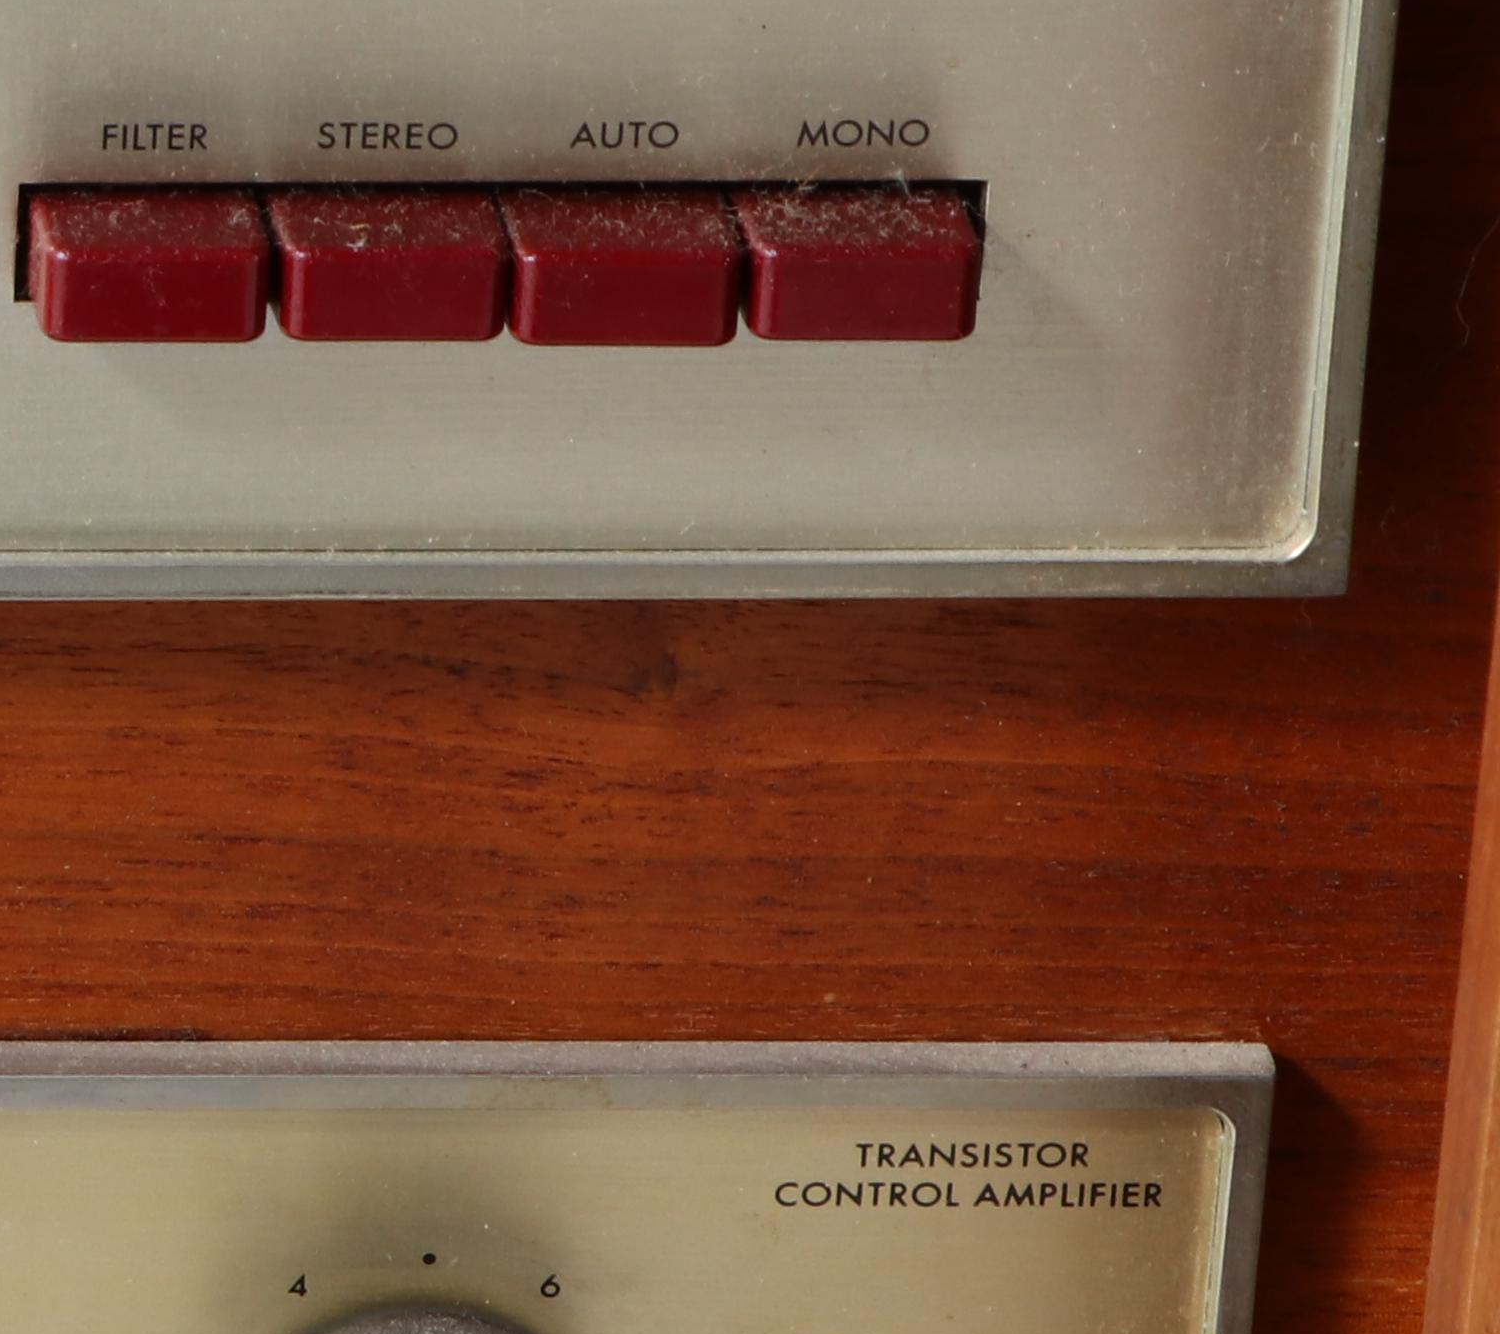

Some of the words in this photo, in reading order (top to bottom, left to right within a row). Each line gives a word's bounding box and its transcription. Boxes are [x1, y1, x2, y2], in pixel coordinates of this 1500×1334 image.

[102, 124, 207, 151] FILTER
[317, 122, 458, 150] STEREO
[570, 121, 679, 150] AUTO
[796, 119, 930, 148] MONO
[856, 1142, 1089, 1168] TRANSISTOR
[774, 1181, 960, 1208] CONTROL
[974, 1182, 1162, 1208] AMPLIFIER
[288, 1274, 307, 1297] 4
[540, 1274, 561, 1298] 6
